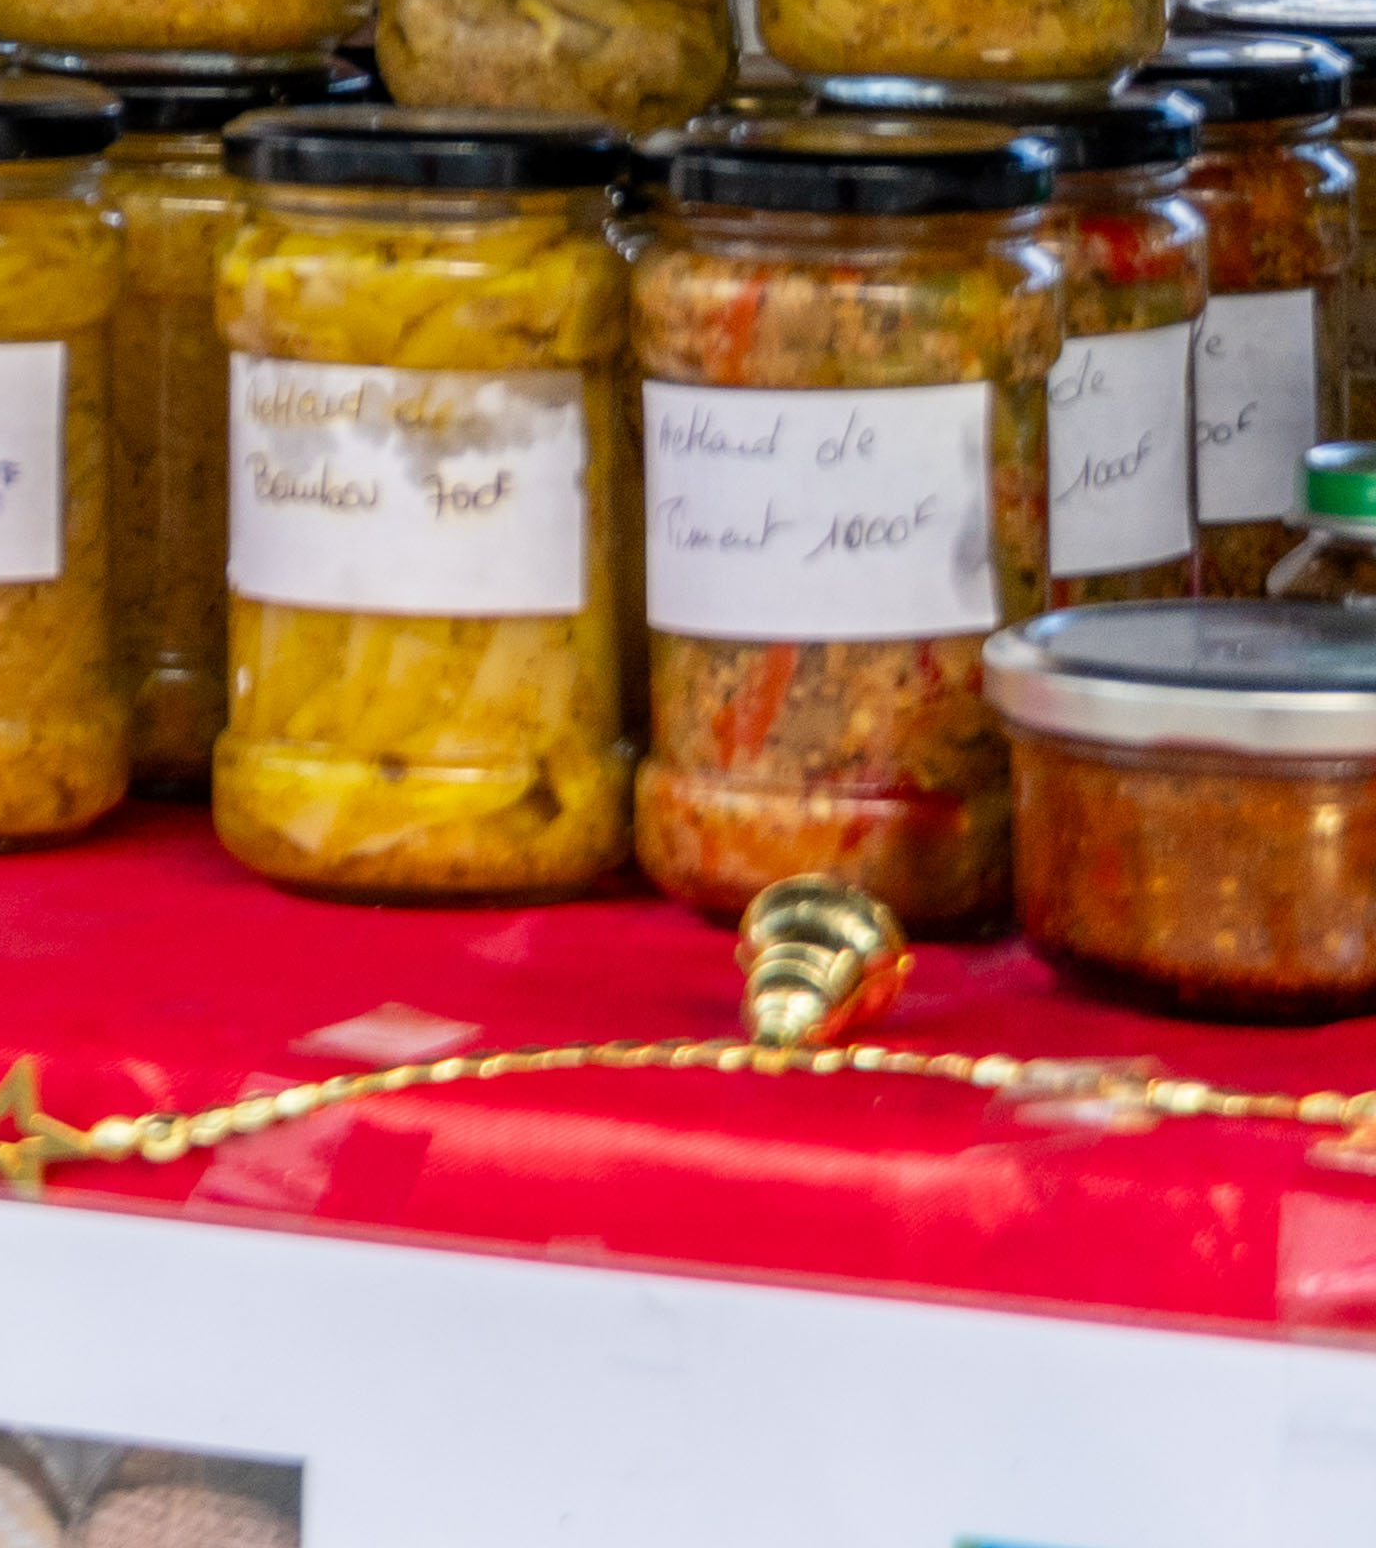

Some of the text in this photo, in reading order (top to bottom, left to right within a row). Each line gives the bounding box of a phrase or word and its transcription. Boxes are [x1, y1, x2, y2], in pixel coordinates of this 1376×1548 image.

[1050, 348, 1110, 411] de
[815, 407, 878, 470] de
[1197, 401, 1257, 447] 00F
